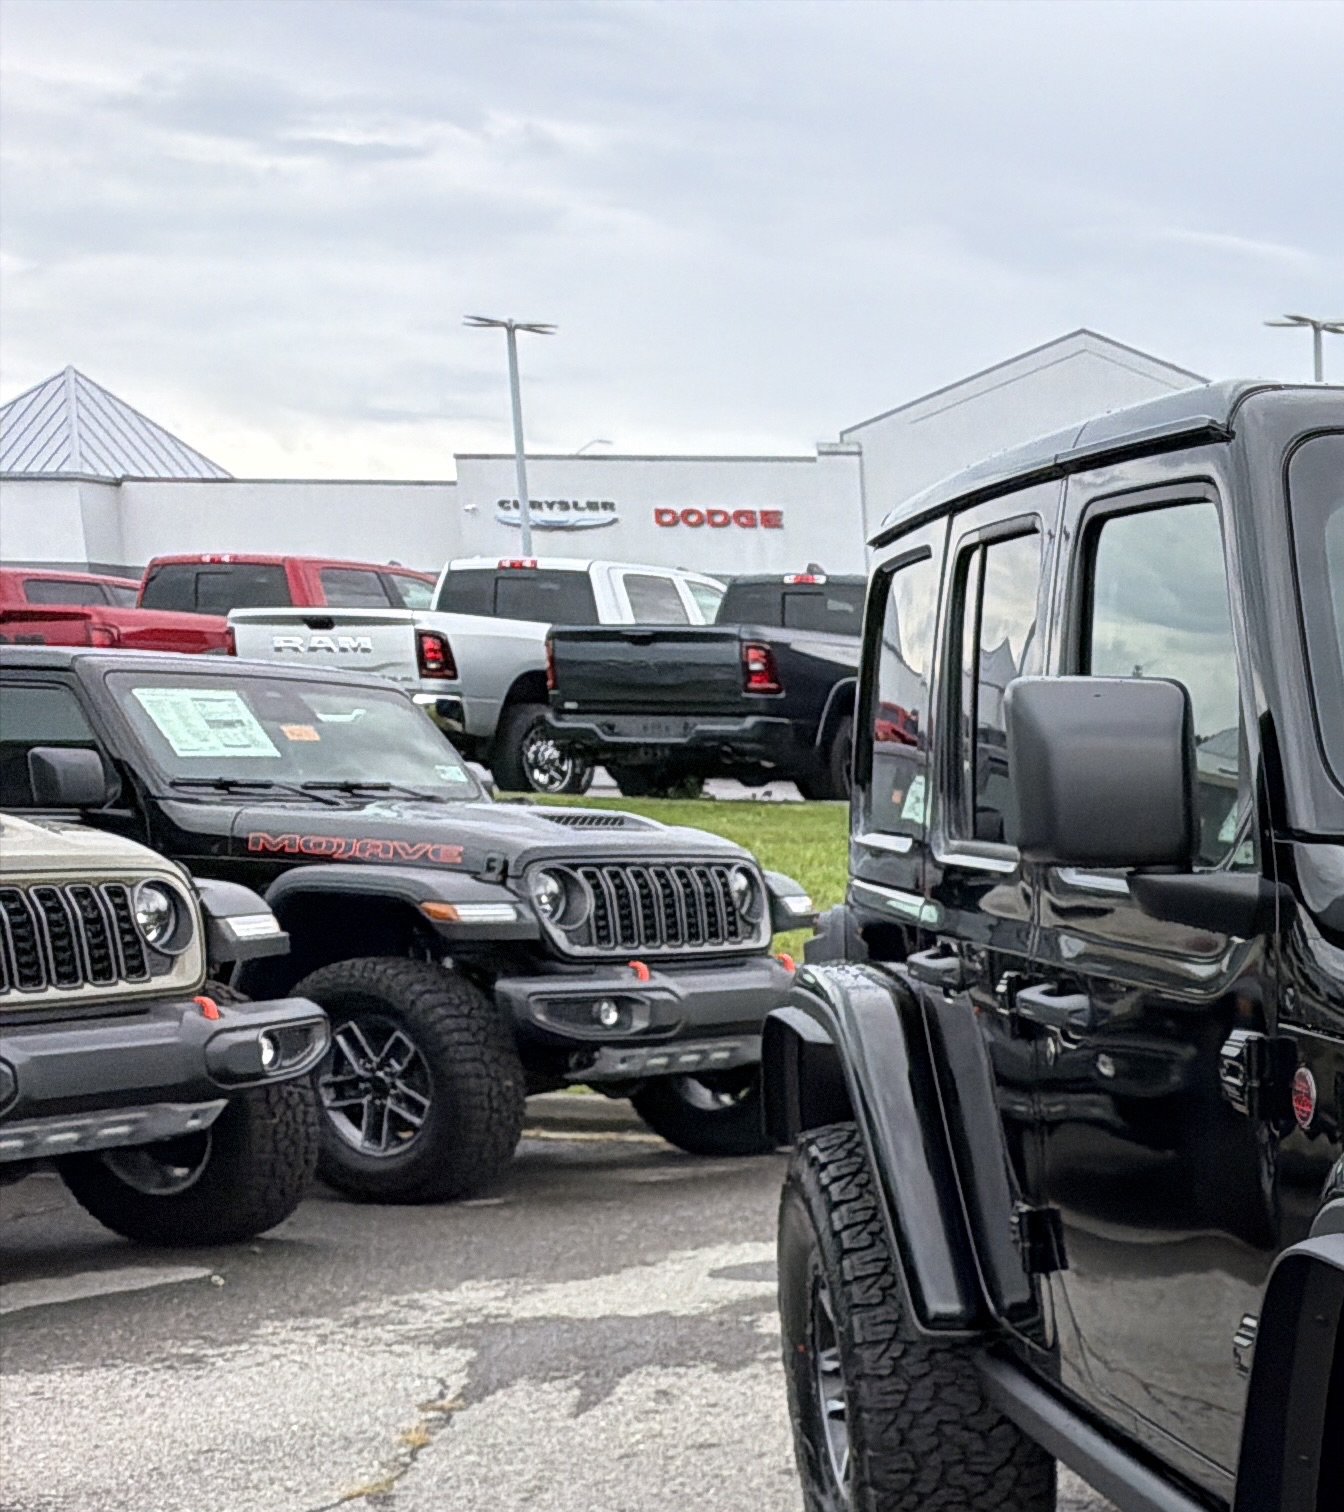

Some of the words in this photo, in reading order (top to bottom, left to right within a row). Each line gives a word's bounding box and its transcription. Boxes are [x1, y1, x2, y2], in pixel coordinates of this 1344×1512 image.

[654, 508, 784, 529] DODGE
[273, 636, 373, 653] RAM
[248, 832, 464, 864] MOJAVE
